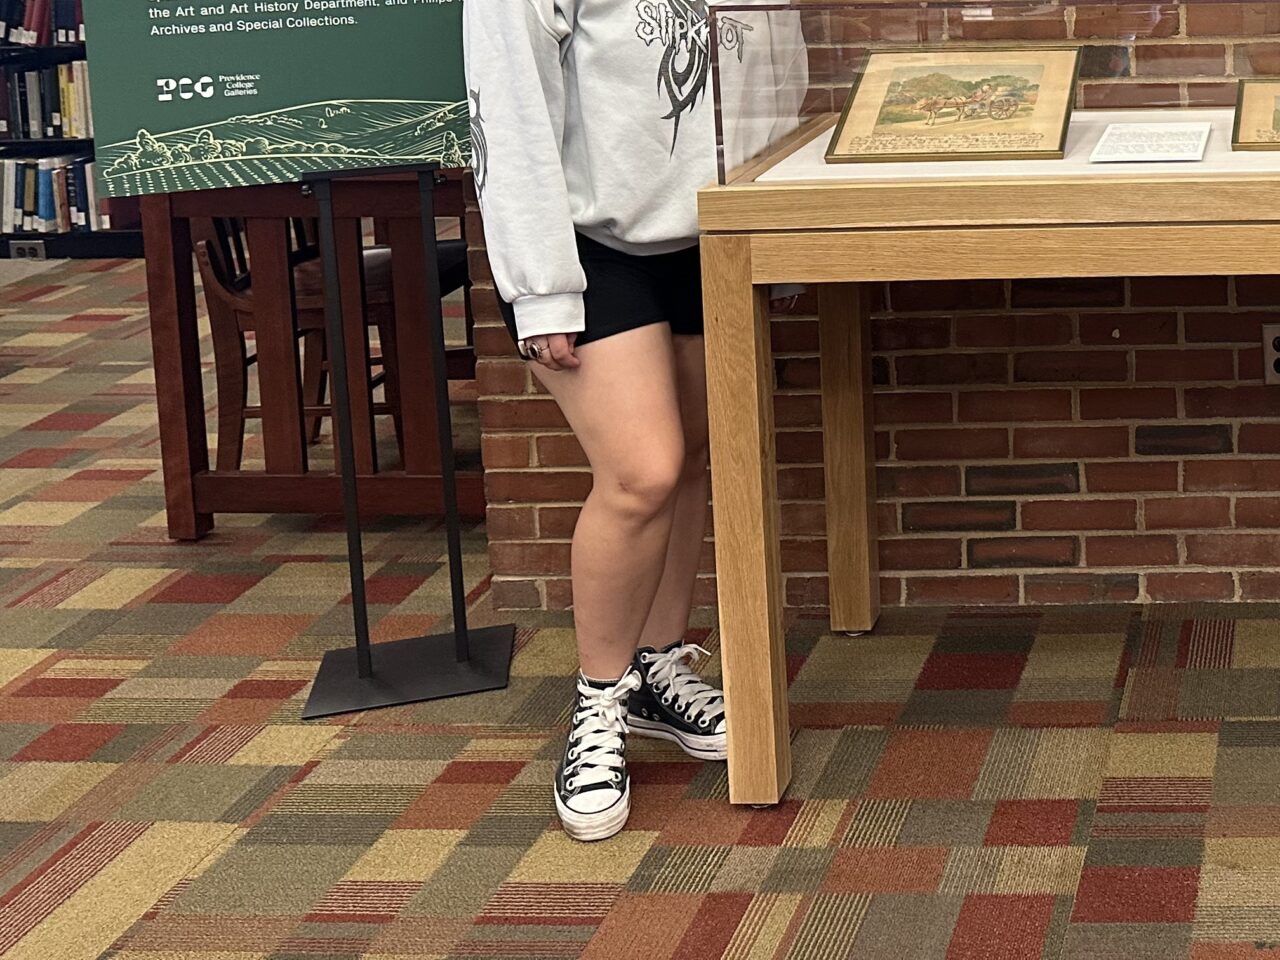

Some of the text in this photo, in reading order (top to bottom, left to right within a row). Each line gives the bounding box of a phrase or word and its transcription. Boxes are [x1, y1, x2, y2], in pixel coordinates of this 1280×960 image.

[150, 24, 206, 36] Archives
[209, 21, 233, 33] and
[236, 18, 283, 33] Special
[218, 74, 261, 82] Providence
[225, 81, 255, 89] College
[223, 88, 258, 97] Galleries
